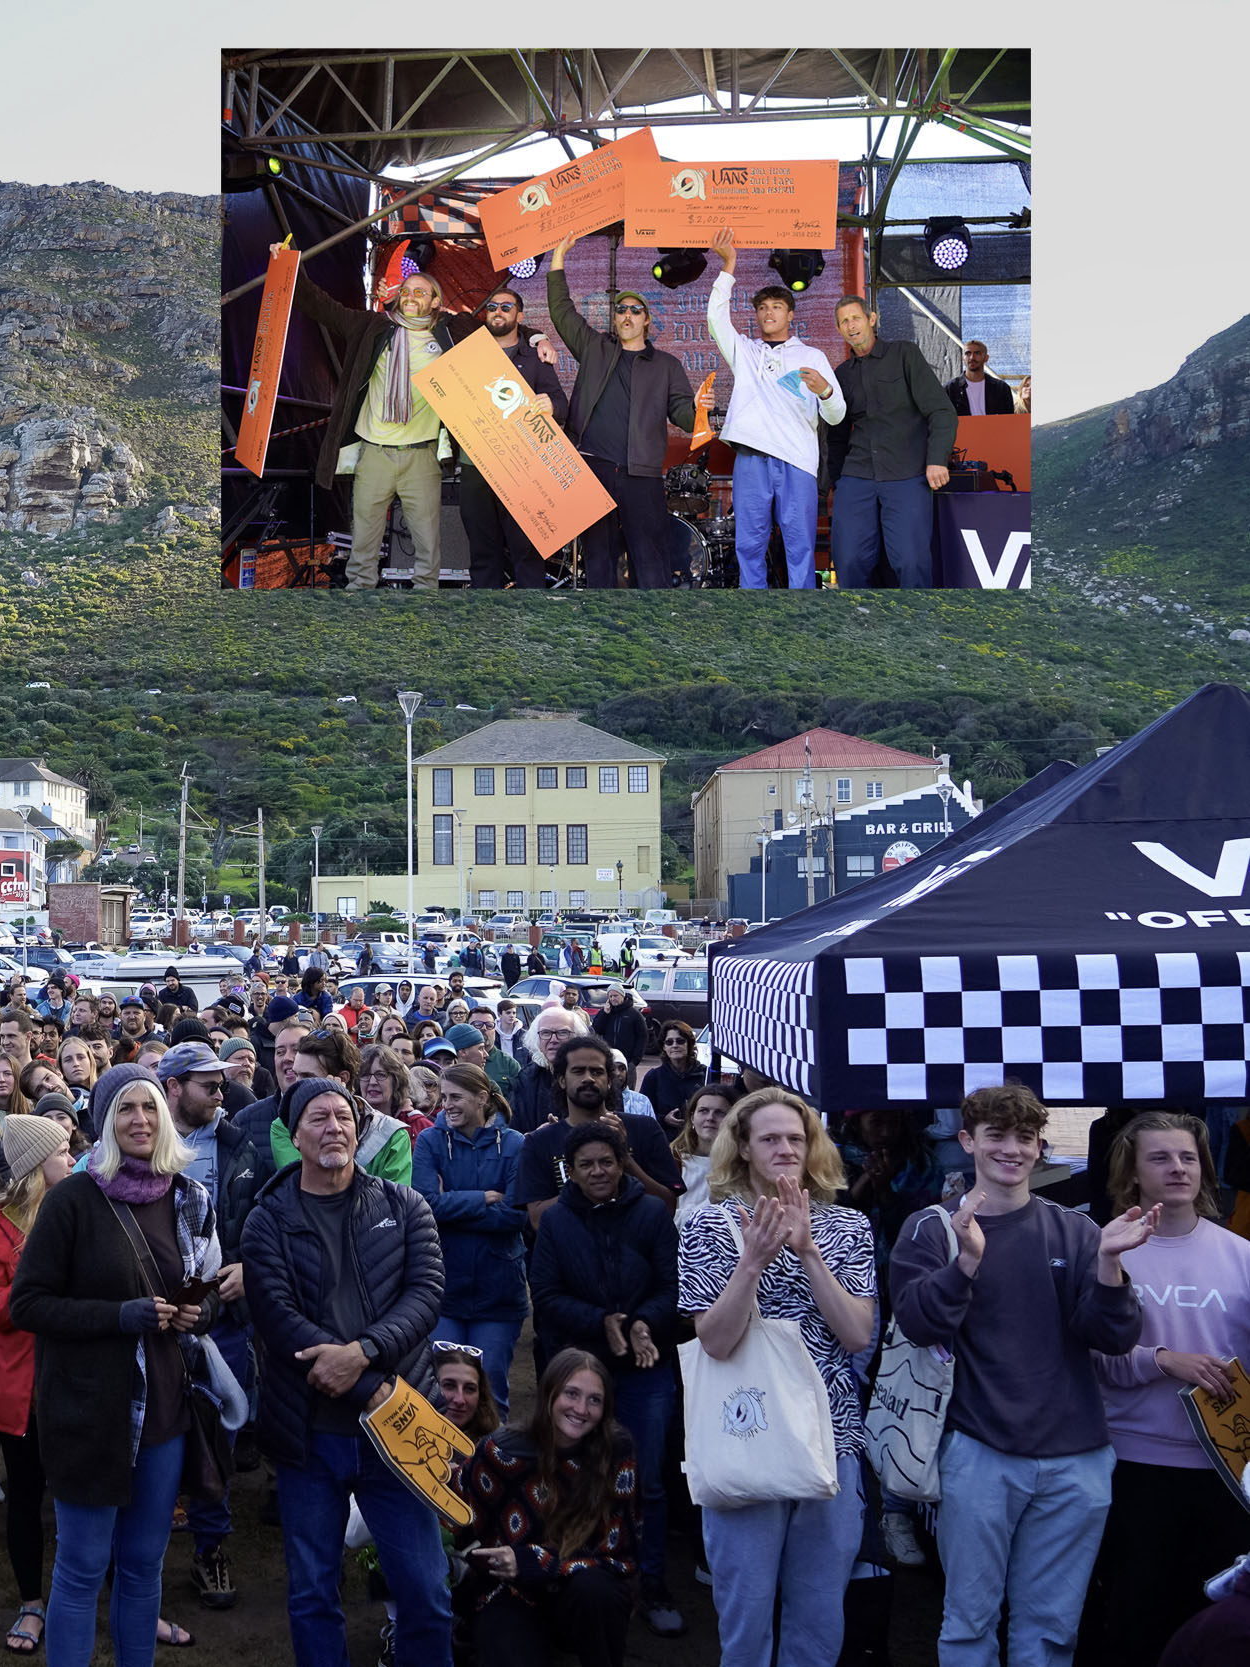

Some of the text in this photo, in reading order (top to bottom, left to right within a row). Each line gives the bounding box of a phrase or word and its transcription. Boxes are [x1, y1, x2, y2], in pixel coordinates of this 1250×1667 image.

[550, 164, 581, 190] VANS
[712, 167, 748, 186] VANS
[540, 202, 567, 219] KEVIN
[523, 409, 556, 444] VANS
[865, 821, 954, 835] BAR & GRILL
[886, 842, 920, 857] STRIPED
[1, 877, 29, 894] cctm
[392, 1402, 419, 1436] VANS
